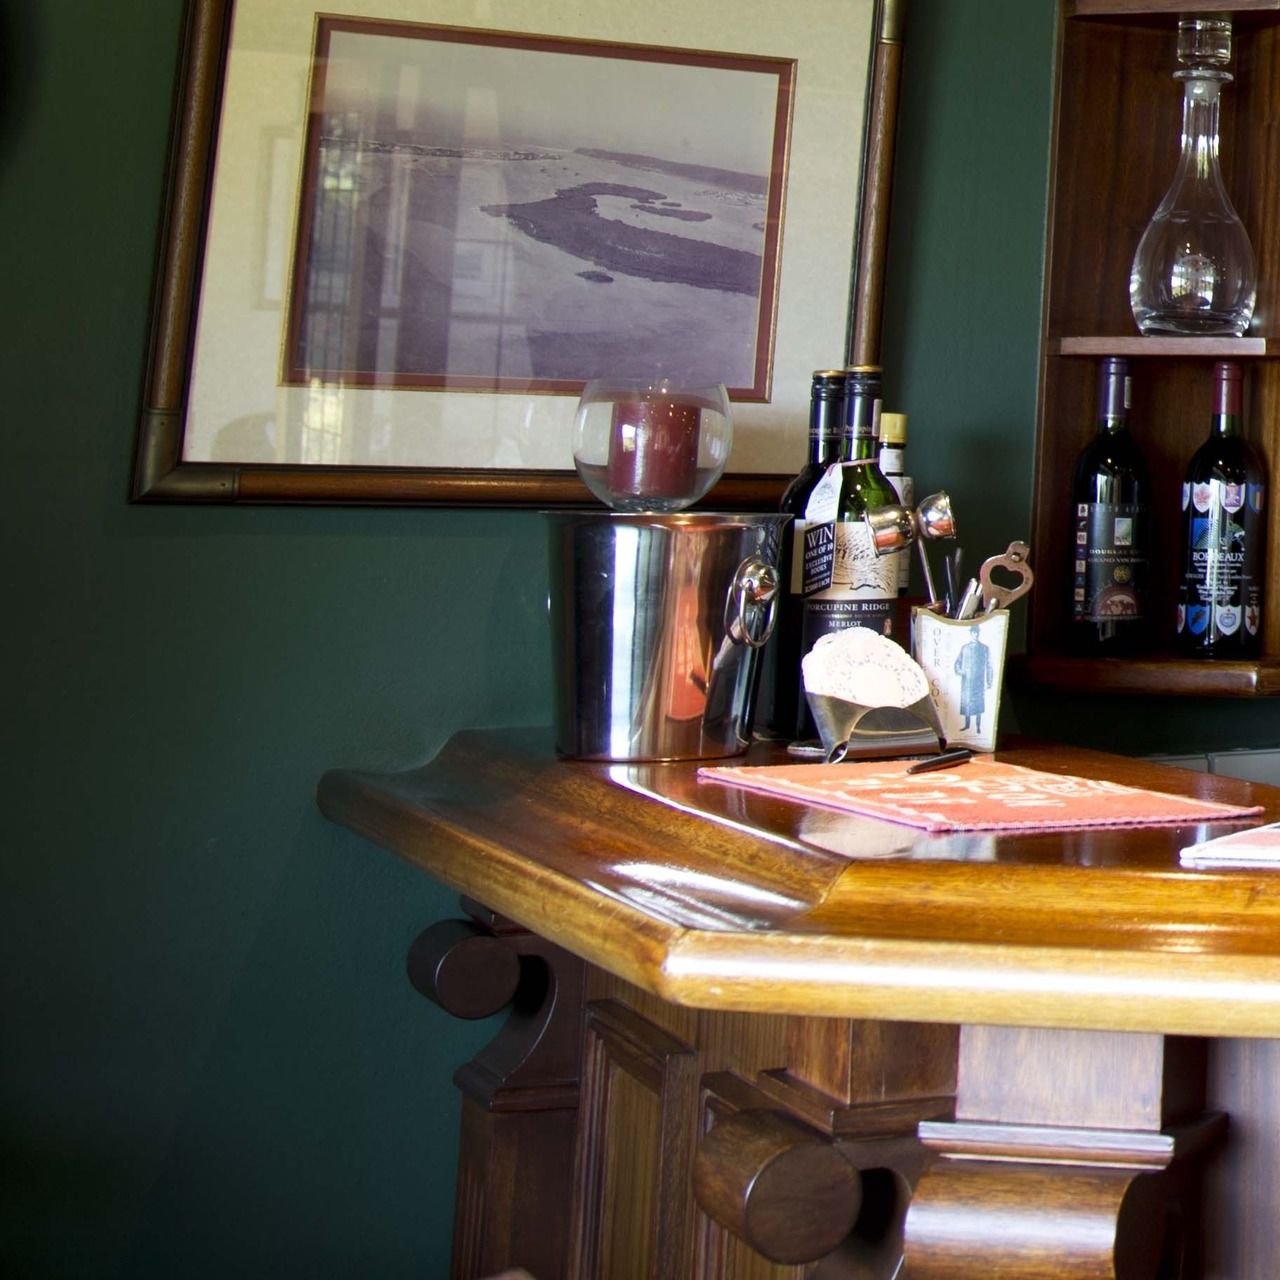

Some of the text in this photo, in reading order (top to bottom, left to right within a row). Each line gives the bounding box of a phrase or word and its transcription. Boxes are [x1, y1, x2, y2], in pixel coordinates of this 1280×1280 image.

[807, 523, 834, 548] WIN
[1192, 552, 1245, 562] BOREAUX
[862, 603, 890, 611] RIDGE
[829, 620, 862, 628] MERLOT
